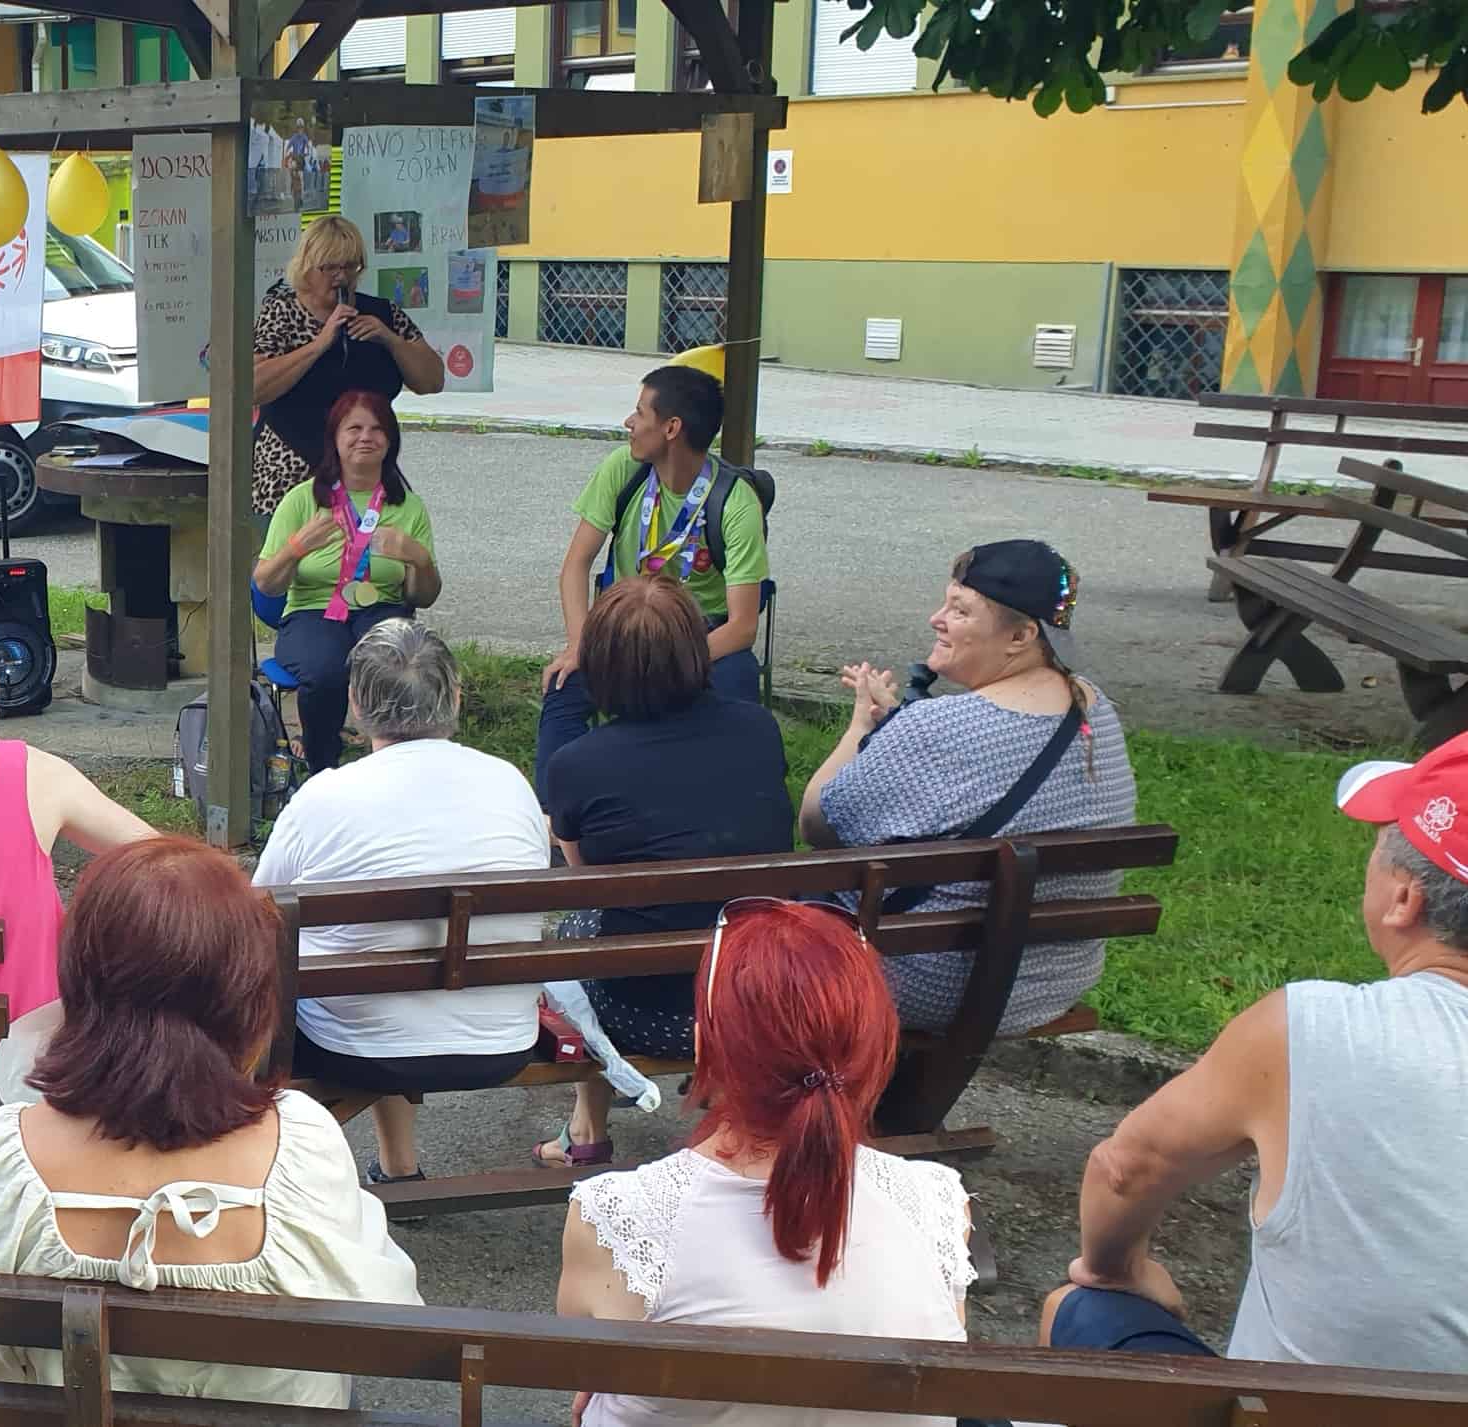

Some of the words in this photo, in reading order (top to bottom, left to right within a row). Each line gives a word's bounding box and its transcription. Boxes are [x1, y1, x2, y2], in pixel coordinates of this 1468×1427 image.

[347, 132, 404, 158] BRAVO
[396, 154, 458, 183] ZORAN
[138, 208, 187, 228] ZORAN
[145, 232, 171, 249] TEK
